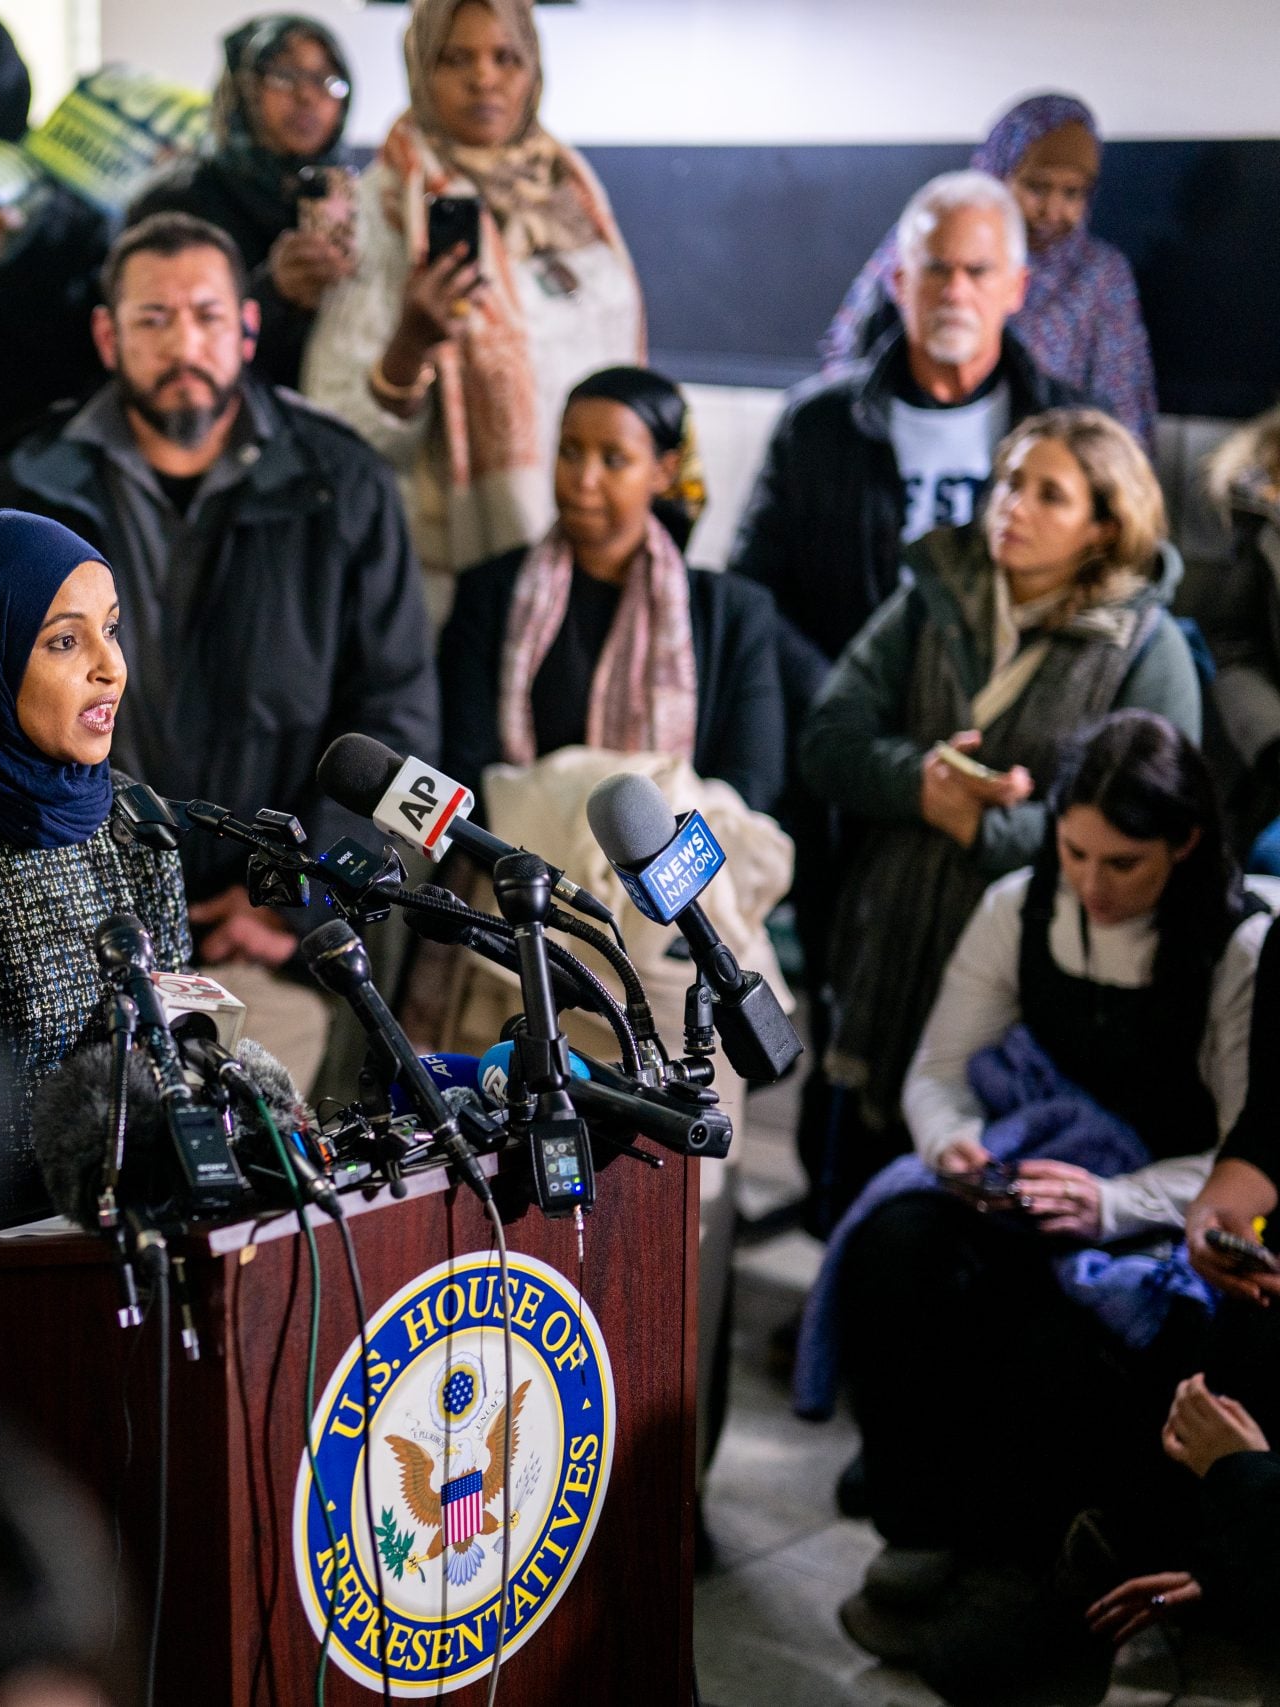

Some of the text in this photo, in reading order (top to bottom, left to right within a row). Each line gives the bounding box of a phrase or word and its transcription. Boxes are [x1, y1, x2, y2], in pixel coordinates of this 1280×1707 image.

[399, 776, 439, 832] AP
[657, 832, 704, 888] NEWS
[666, 847, 713, 902] NATION
[329, 1276, 589, 1438] U.S. HOUSE OF
[316, 1434, 599, 1671] REPRESENTATIVES
